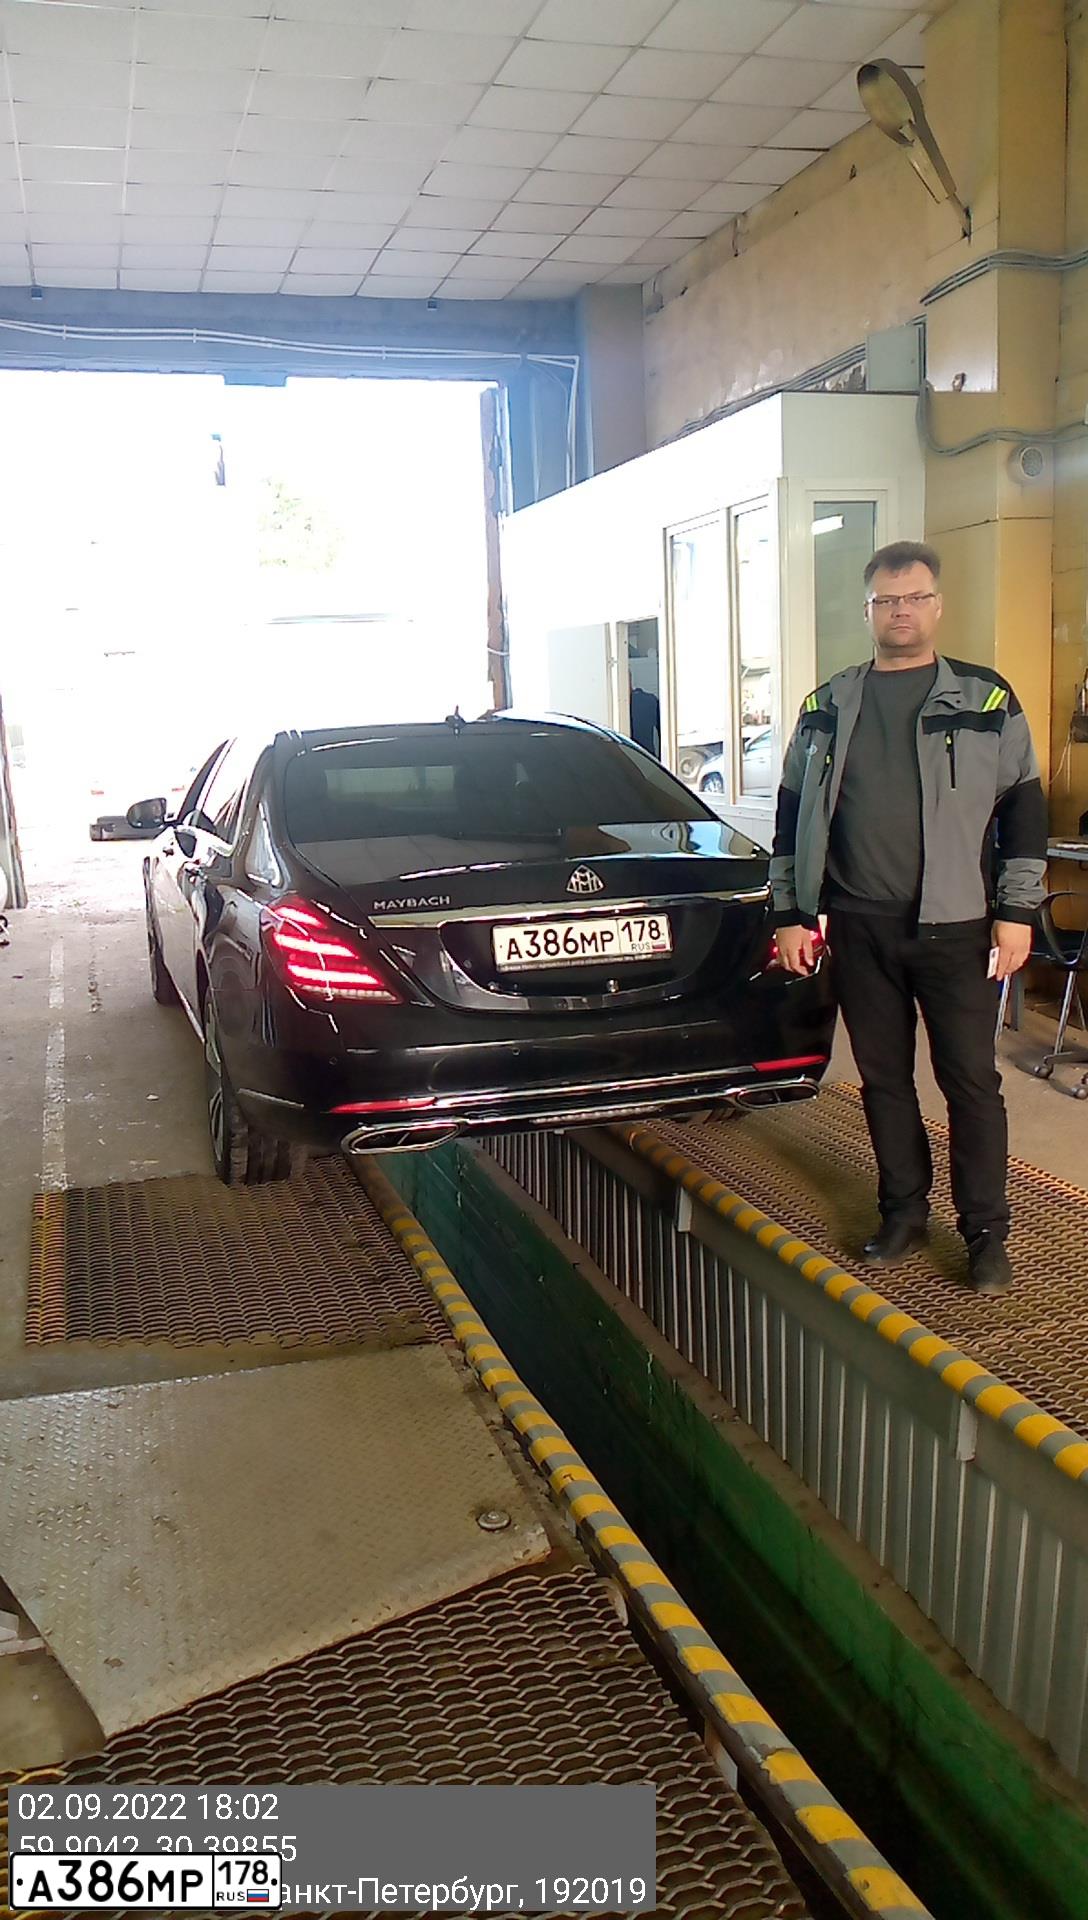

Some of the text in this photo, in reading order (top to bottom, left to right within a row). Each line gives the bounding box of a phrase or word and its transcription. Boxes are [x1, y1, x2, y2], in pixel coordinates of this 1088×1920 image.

[373, 895, 451, 910] MAYBACH
[621, 919, 661, 942] 178
[631, 942, 650, 952] RUS
